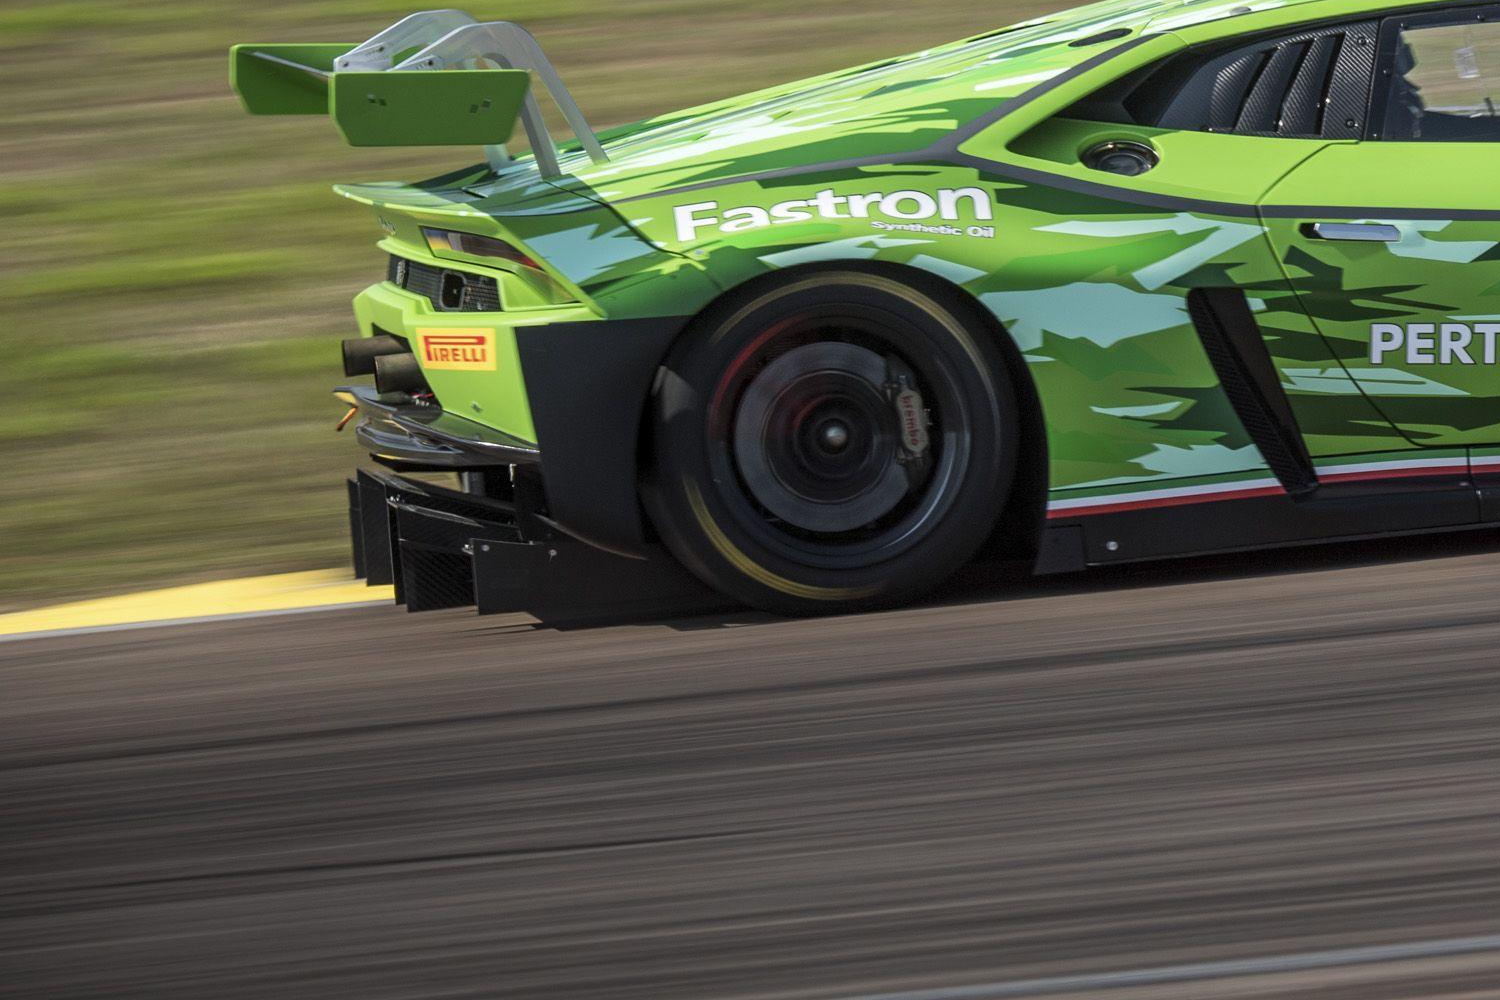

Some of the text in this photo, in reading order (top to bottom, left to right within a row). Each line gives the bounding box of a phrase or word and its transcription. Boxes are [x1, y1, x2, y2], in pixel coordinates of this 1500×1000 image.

[672, 186, 993, 242] Fastron
[966, 225, 995, 238] Oil
[423, 335, 487, 362] PIRELLI
